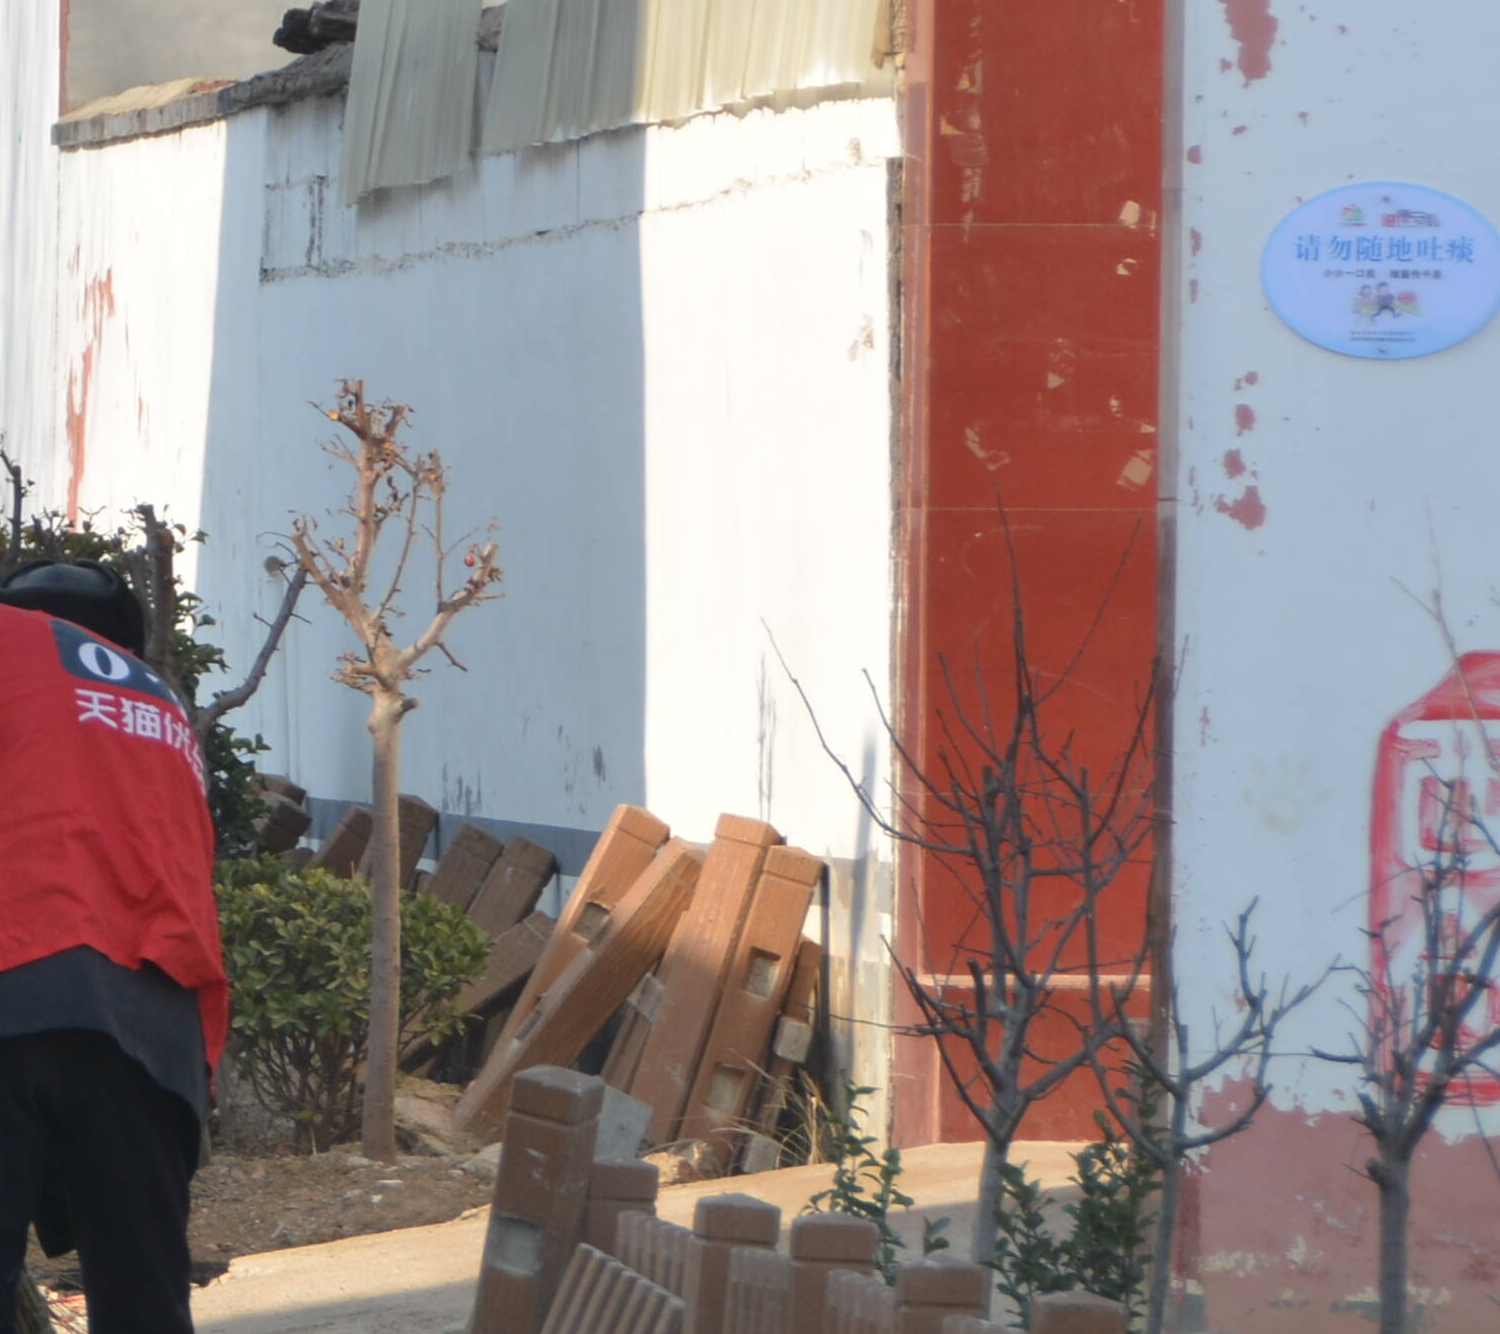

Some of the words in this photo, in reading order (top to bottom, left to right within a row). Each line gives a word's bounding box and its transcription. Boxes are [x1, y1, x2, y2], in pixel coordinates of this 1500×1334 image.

[1295, 235, 1475, 263] 请勿随地吐痰
